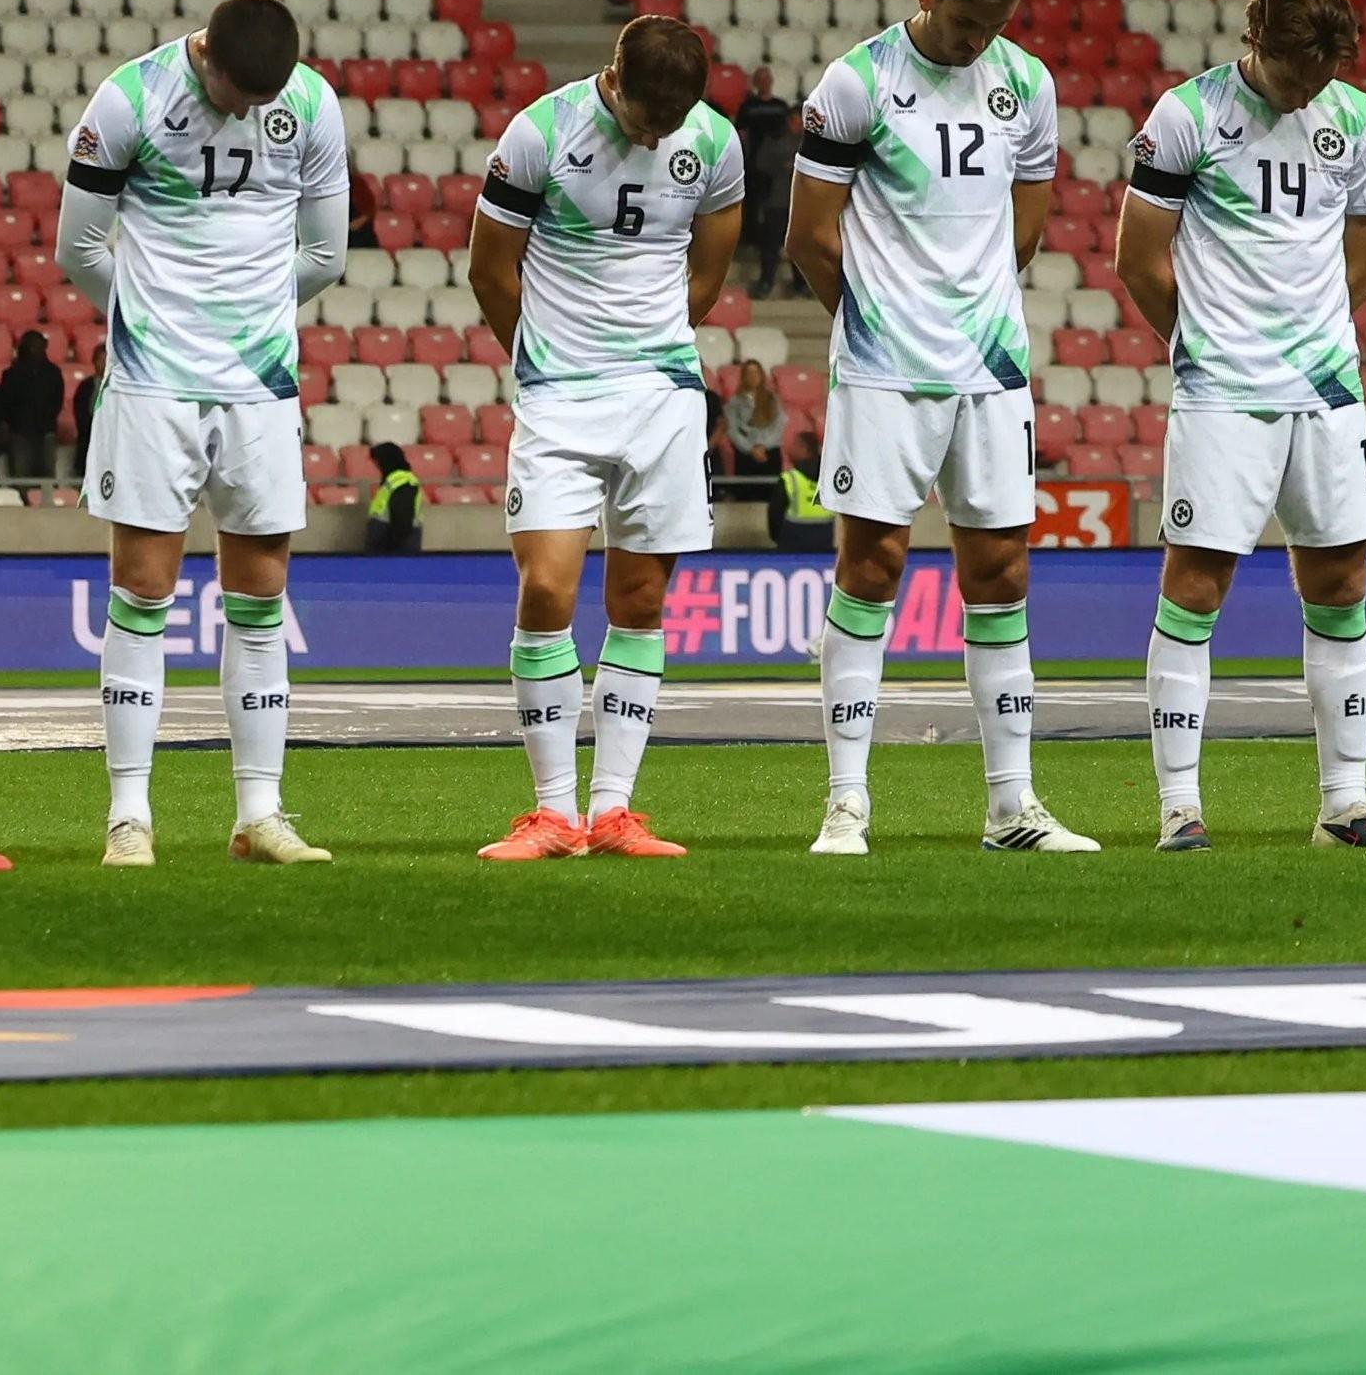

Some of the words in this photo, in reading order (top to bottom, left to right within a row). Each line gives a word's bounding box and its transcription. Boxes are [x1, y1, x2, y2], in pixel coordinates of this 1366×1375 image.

[935, 123, 985, 178] 12
[201, 145, 253, 199] 17
[1257, 159, 1307, 218] 14
[612, 183, 645, 237] 6
[102, 686, 154, 706] ÉIRE
[242, 692, 290, 711] ÉIR
[996, 693, 1033, 716] ÉIR
[518, 705, 562, 727] IRE
[1153, 708, 1199, 730] ÉIRE
